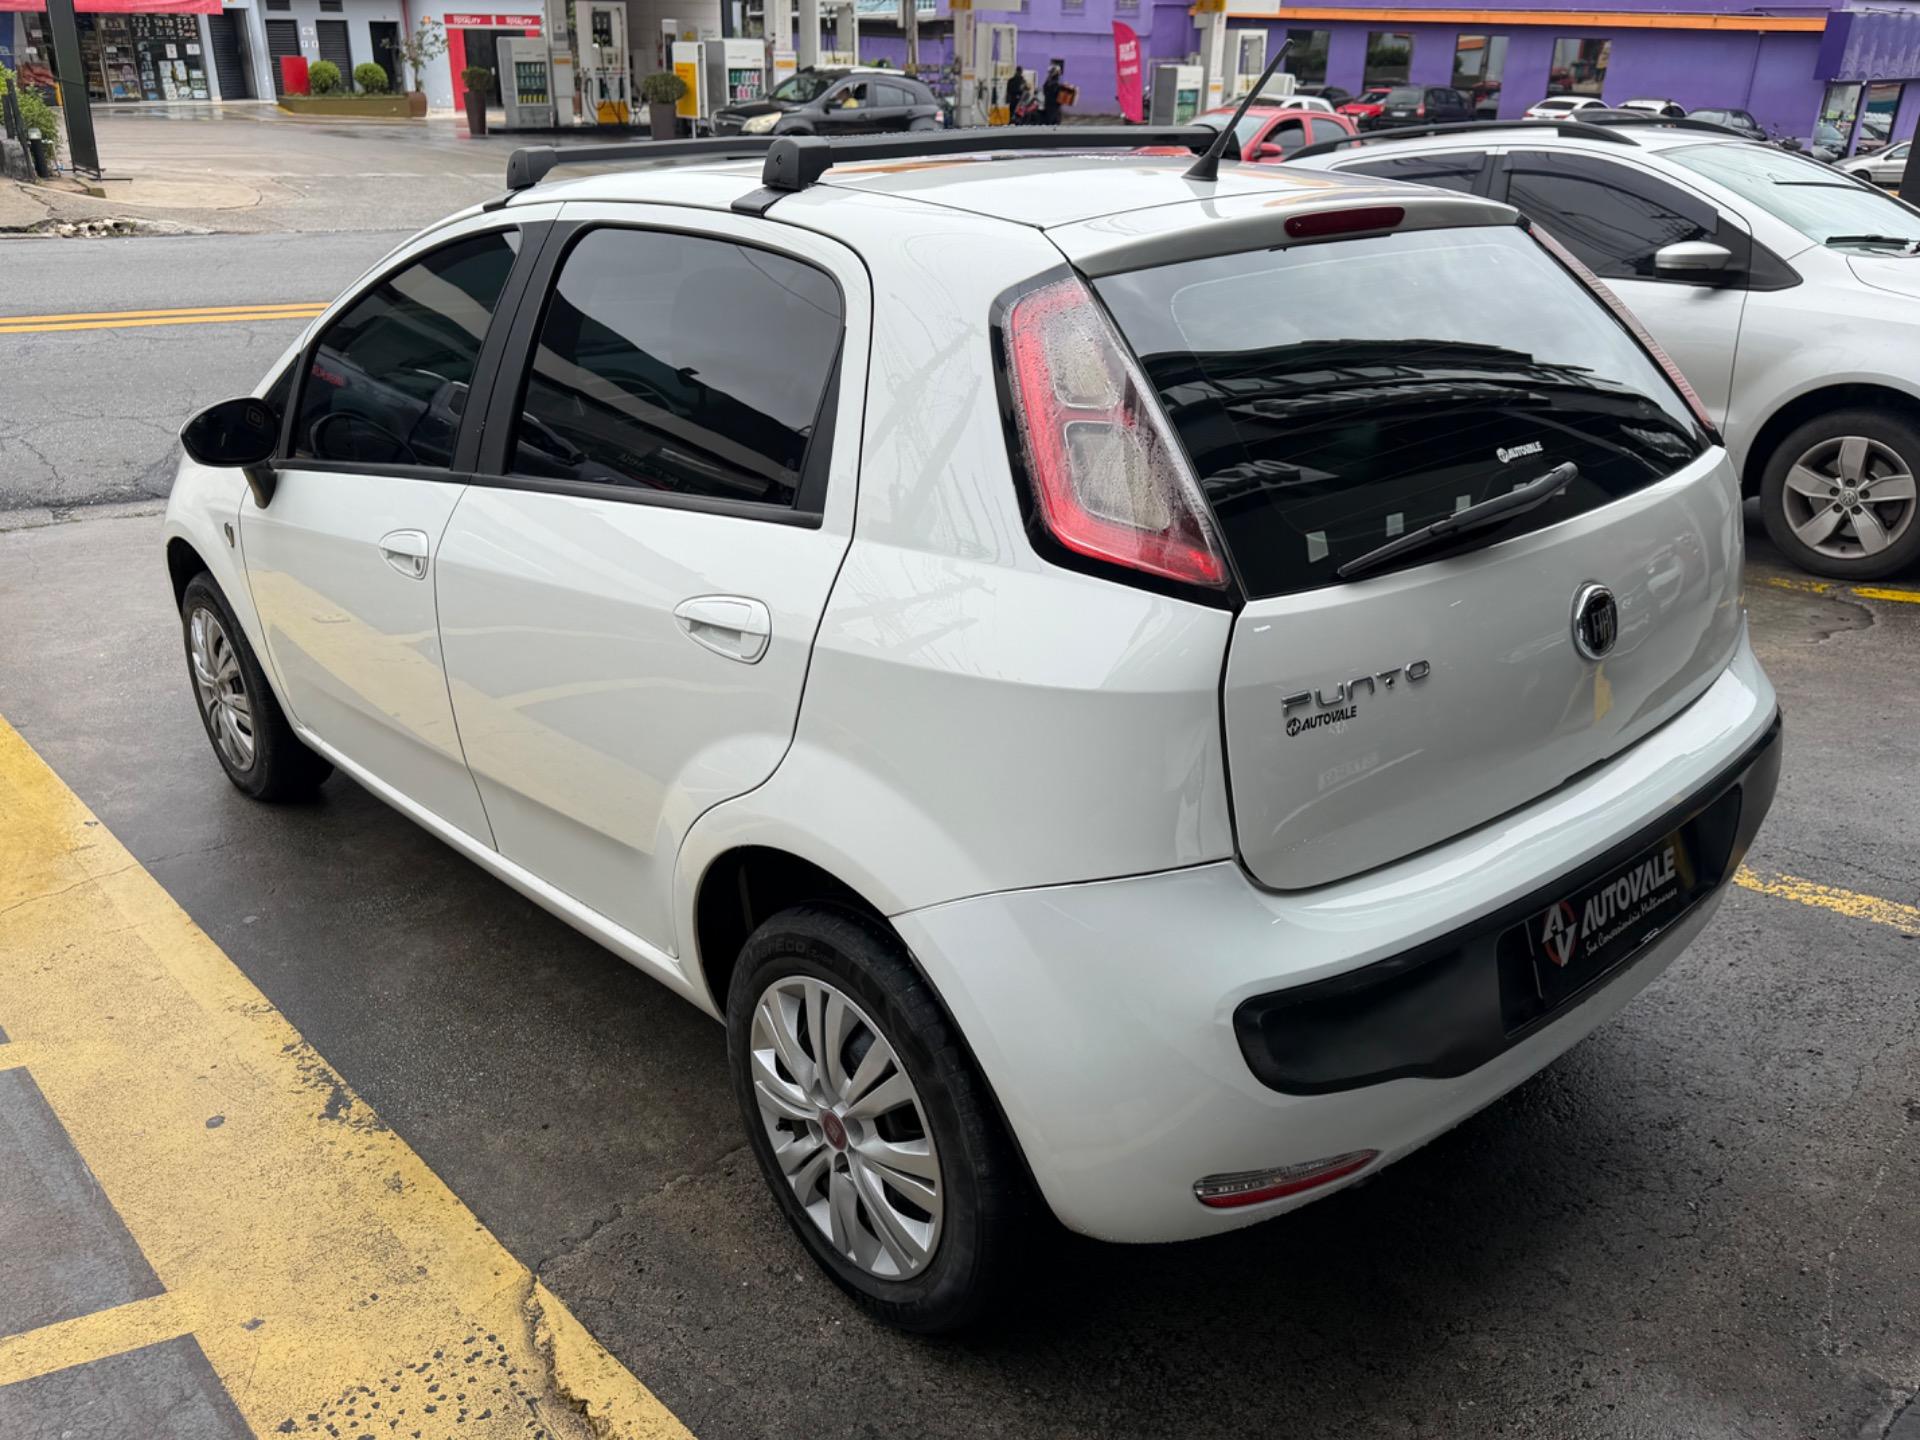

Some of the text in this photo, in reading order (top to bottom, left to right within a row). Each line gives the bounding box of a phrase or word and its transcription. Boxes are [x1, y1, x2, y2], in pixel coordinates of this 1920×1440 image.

[1281, 659, 1431, 718] PUNTO
[1301, 705, 1357, 731] AUTOVALE
[1581, 846, 1677, 939] AUTOVALE
